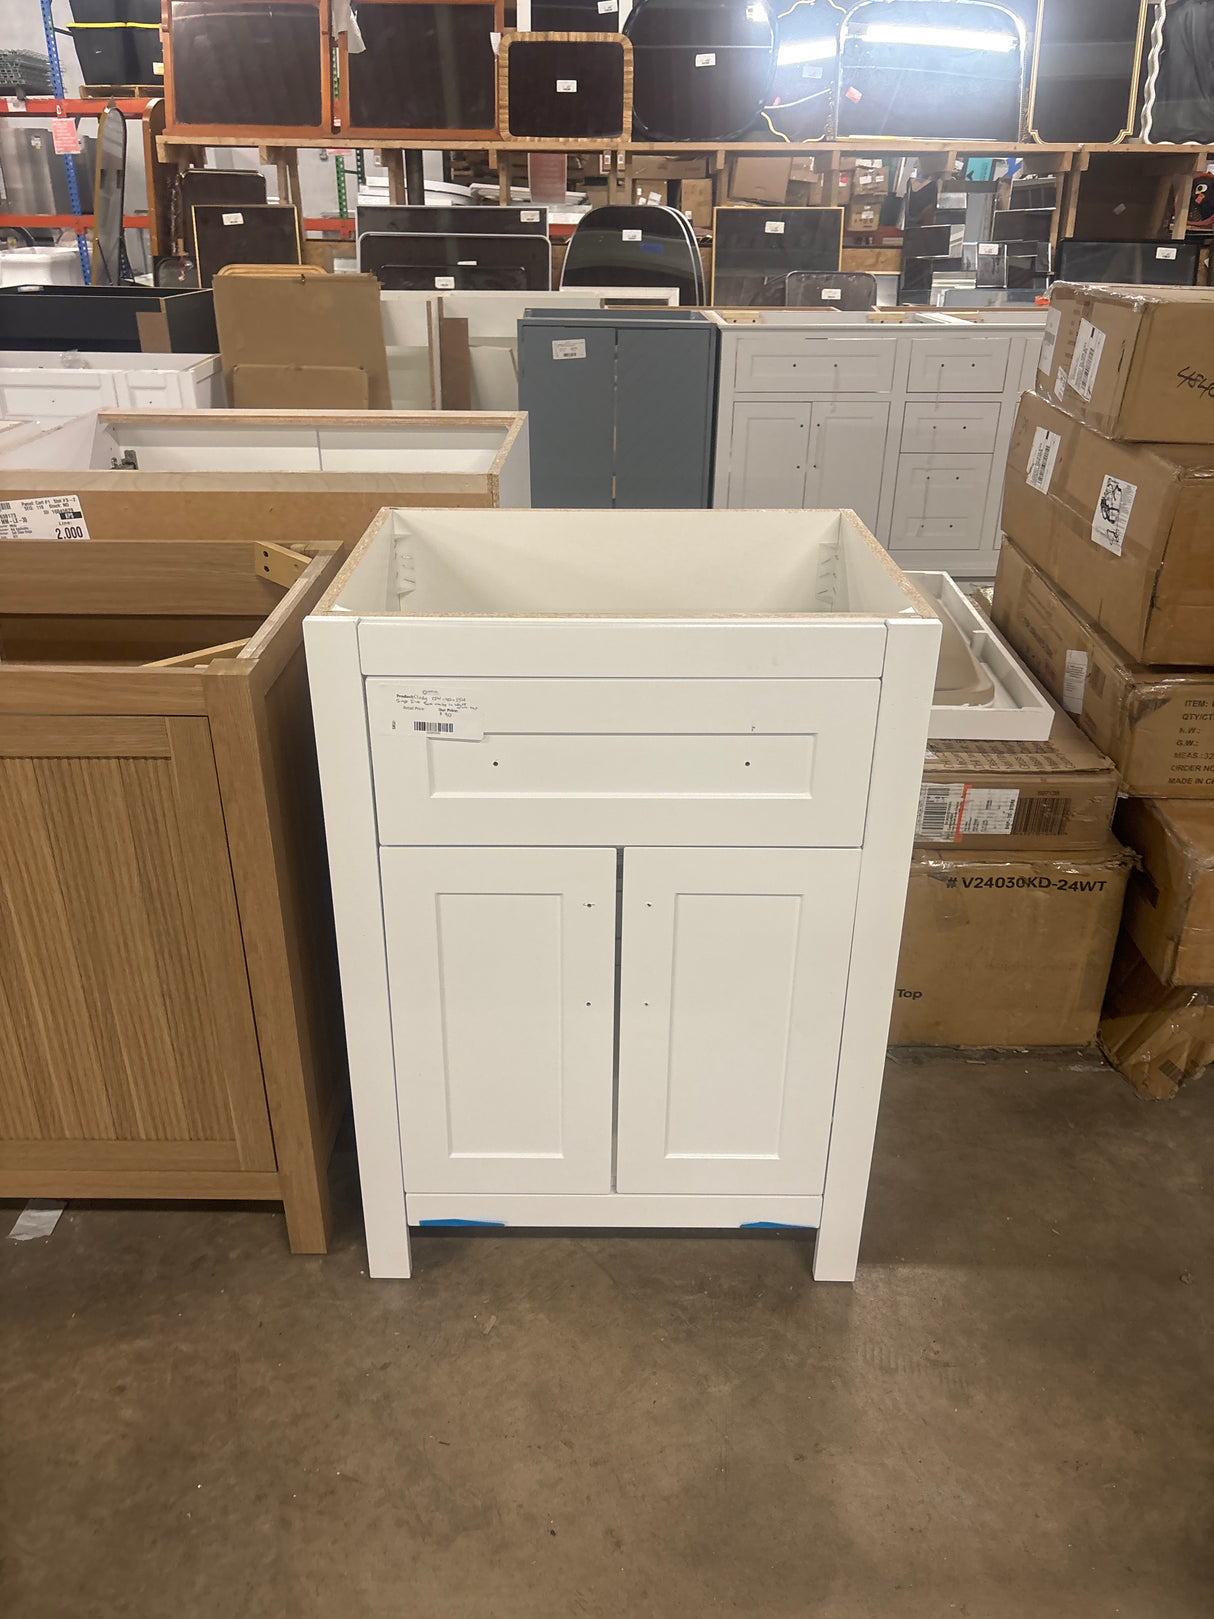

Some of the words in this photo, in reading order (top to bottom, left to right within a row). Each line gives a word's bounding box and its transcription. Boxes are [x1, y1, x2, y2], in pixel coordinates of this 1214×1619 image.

[55, 526, 84, 540] 2.000
[1185, 700, 1209, 708] ITEM:
[1170, 764, 1202, 772] ORDER
[1168, 777, 1193, 785] MADE
[1195, 777, 1204, 785] IN
[946, 877, 958, 889] #
[896, 988, 923, 1001] Top
